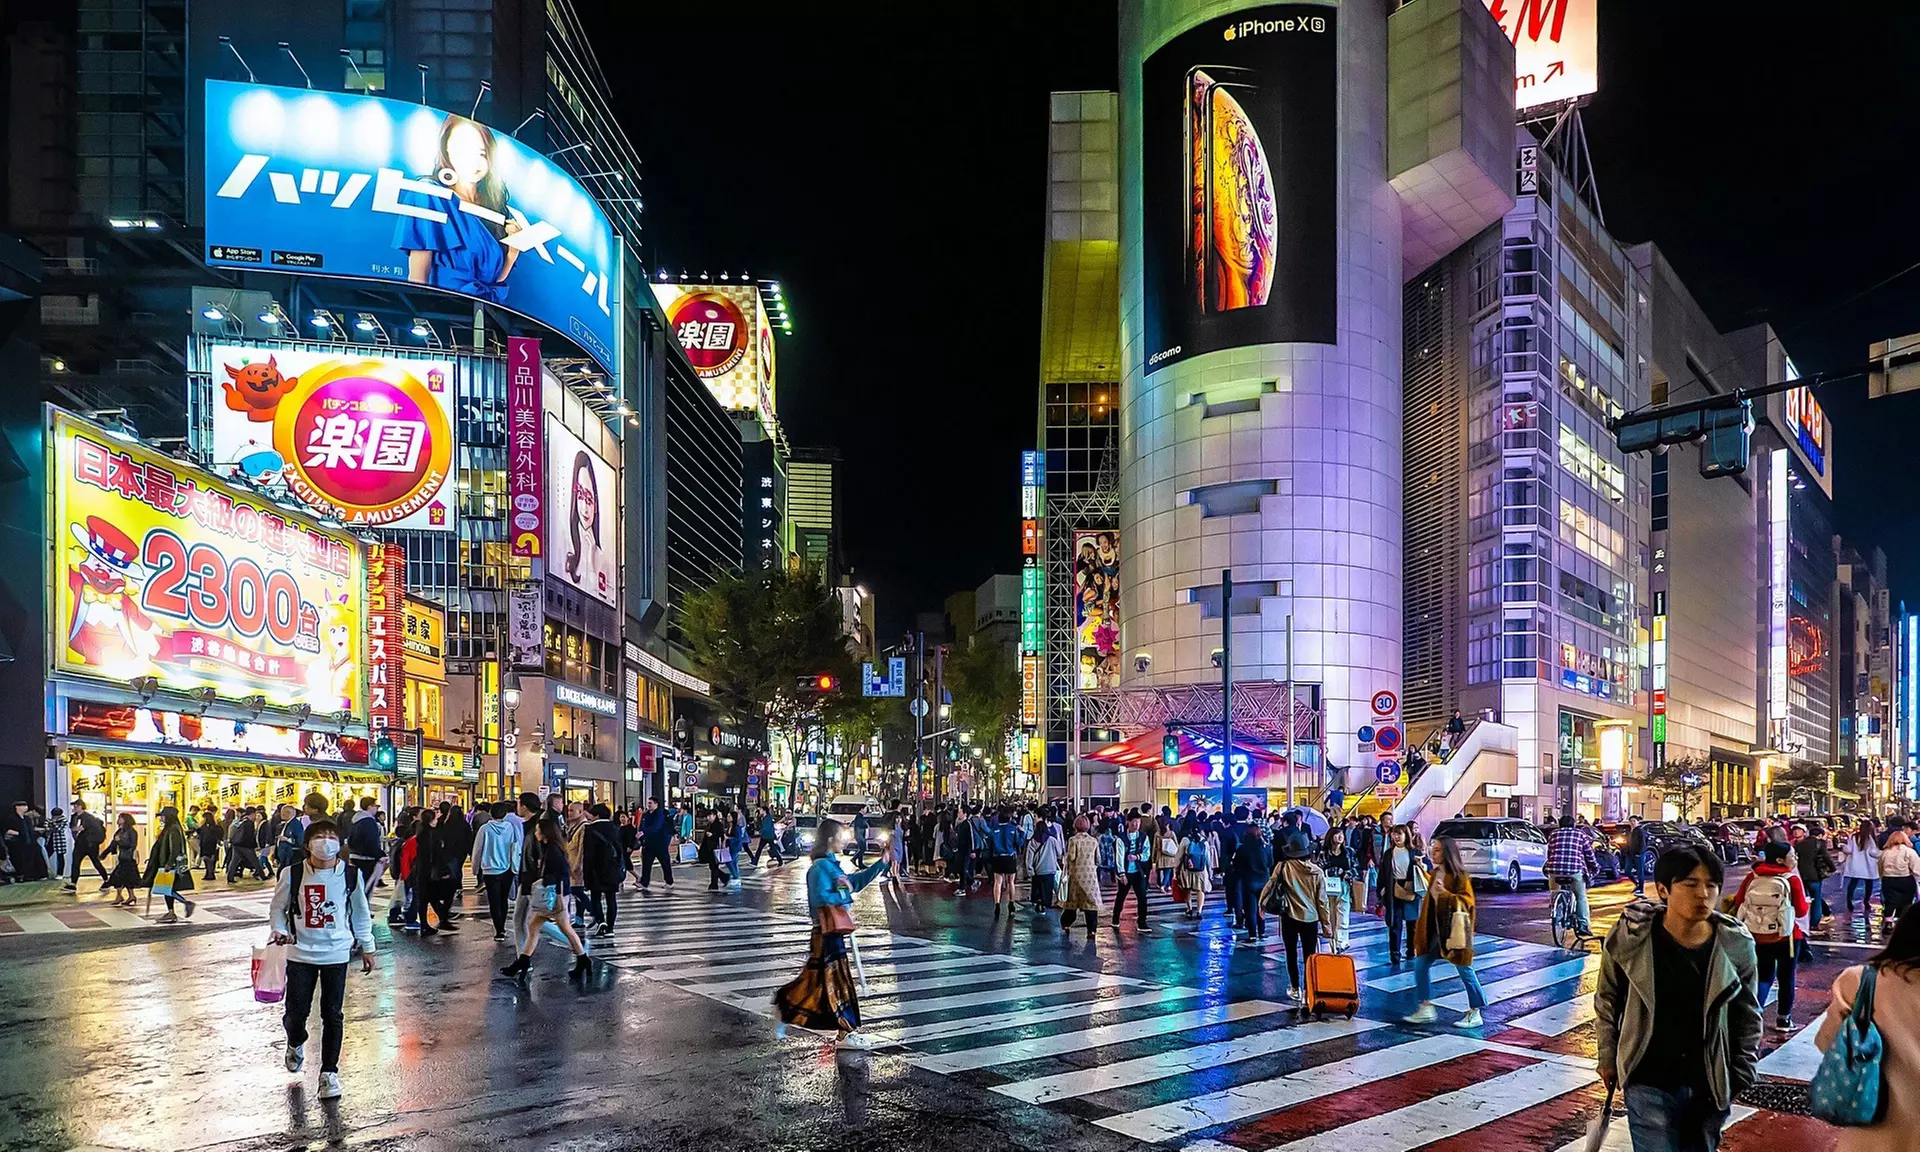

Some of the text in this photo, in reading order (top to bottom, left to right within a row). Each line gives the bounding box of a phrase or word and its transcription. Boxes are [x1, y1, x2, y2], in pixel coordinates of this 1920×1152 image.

[1239, 20, 1295, 38] iPhone
[1522, 149, 1536, 187] 玉久
[216, 153, 612, 318] ハッピーメール
[226, 247, 239, 256] App
[286, 253, 316, 263] Google Play
[677, 320, 735, 350] 楽園
[699, 347, 744, 378] AMUSEMENT
[1149, 345, 1181, 366] docomo
[303, 412, 426, 473] 楽園
[514, 366, 537, 492] 品川美容外科
[74, 437, 350, 578] 日本最大級の超大型店
[353, 469, 445, 524] AMUSEMENT
[431, 508, 443, 516] 30
[145, 532, 299, 643] 2300
[371, 543, 386, 611] パチンコ
[301, 606, 317, 635] 台
[406, 614, 431, 640] 野家
[372, 616, 387, 708] エスパス
[402, 639, 432, 656] SHINOYA
[1024, 663, 1035, 719] HOOTERS
[1376, 697, 1392, 709] 30
[506, 735, 514, 748] 3
